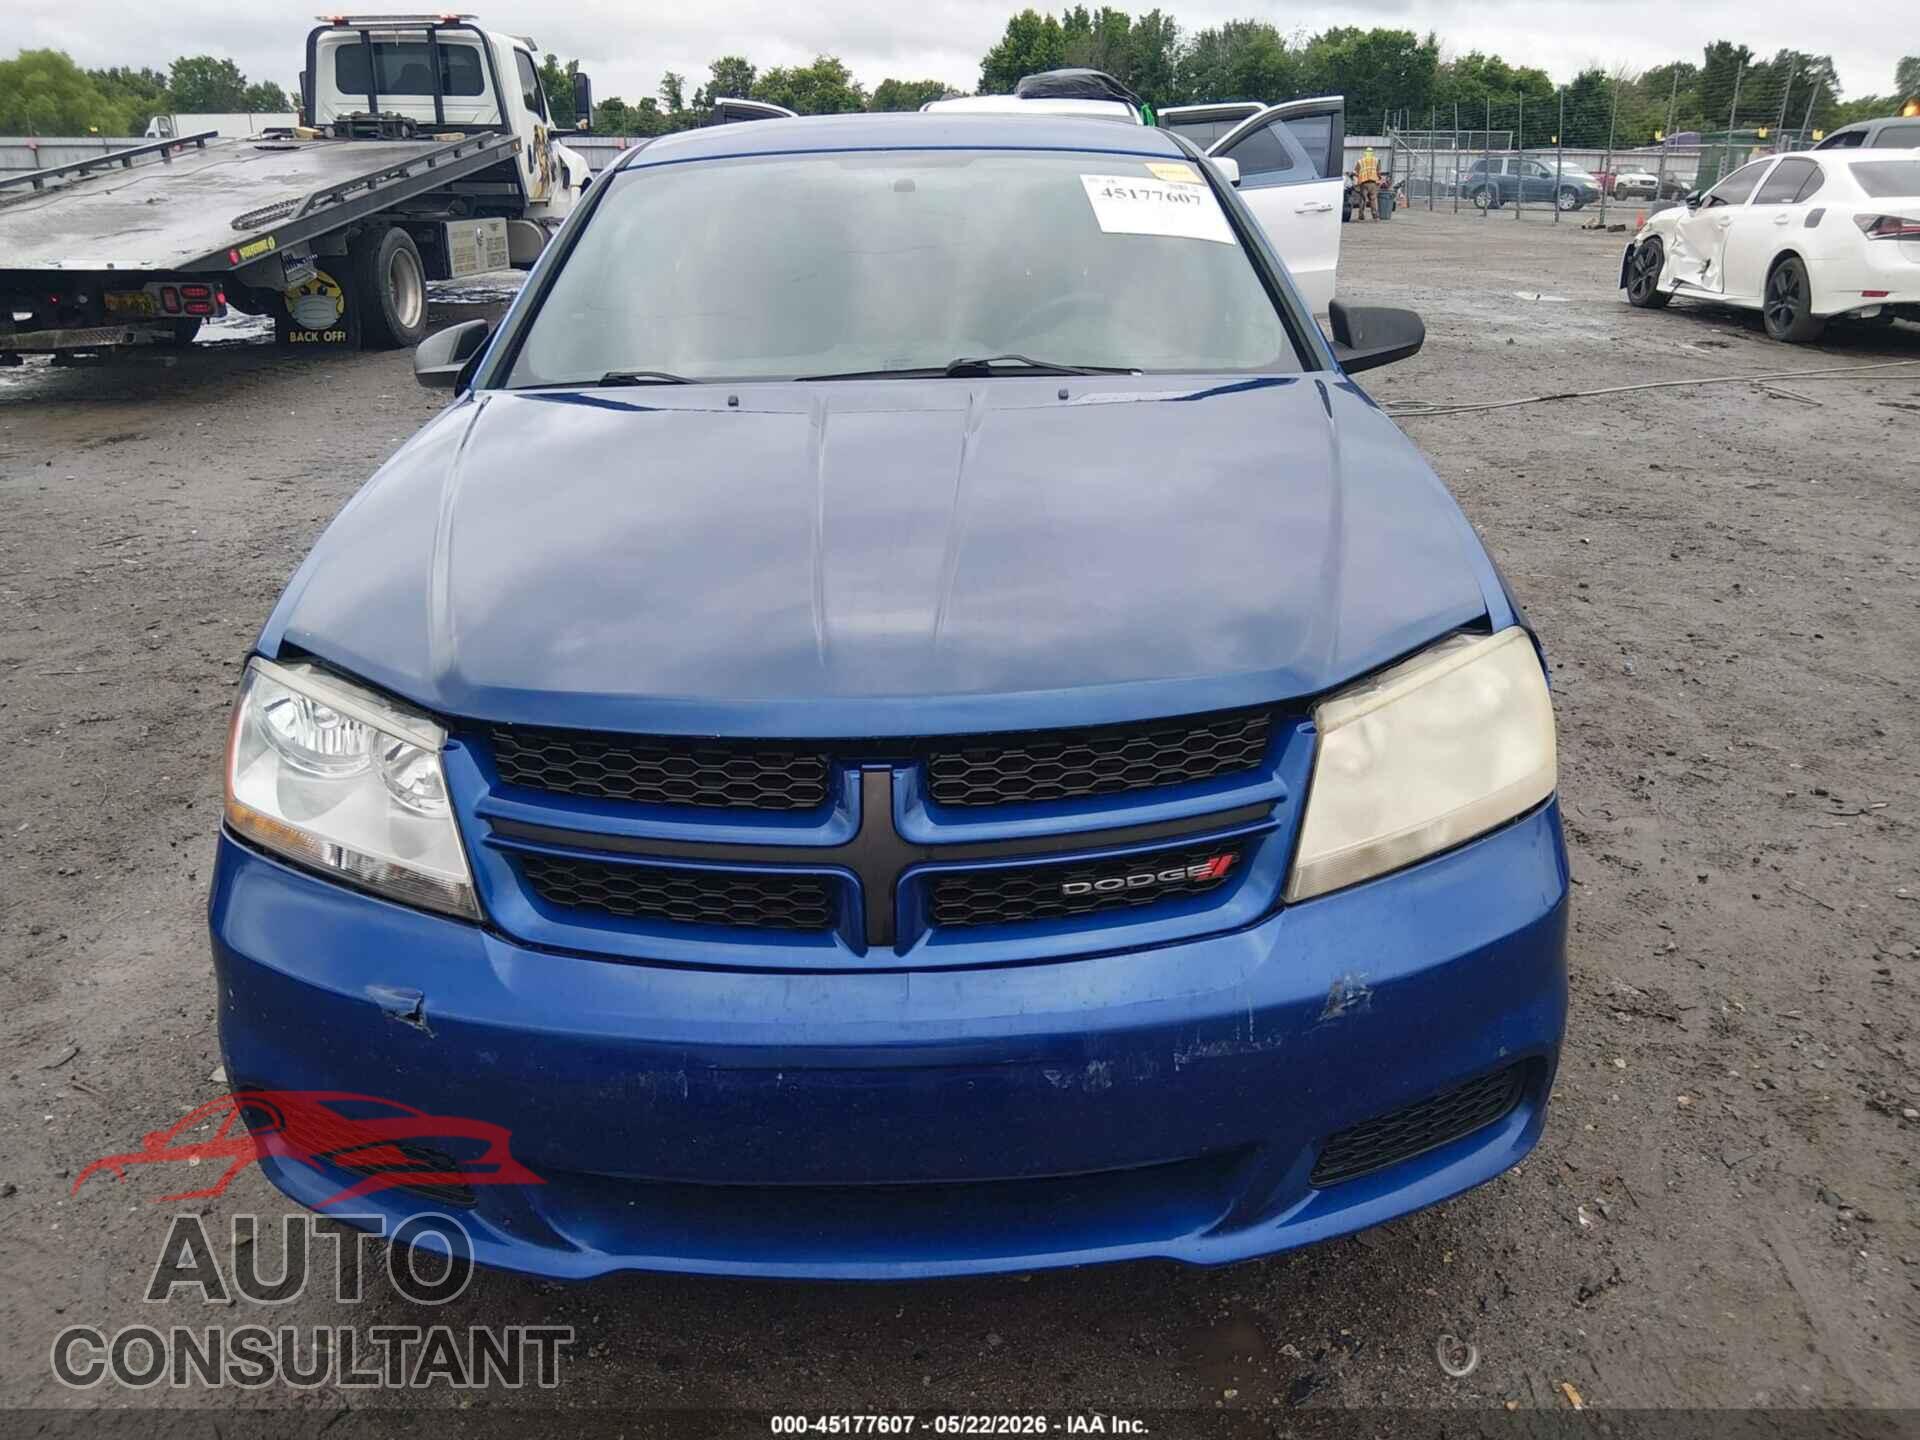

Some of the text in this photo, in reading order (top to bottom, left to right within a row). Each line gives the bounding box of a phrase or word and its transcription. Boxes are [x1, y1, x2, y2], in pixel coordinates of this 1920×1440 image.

[1101, 187, 1201, 206] 45177607
[289, 331, 346, 342] BACK OFF!
[1062, 862, 1214, 896] DODGE
